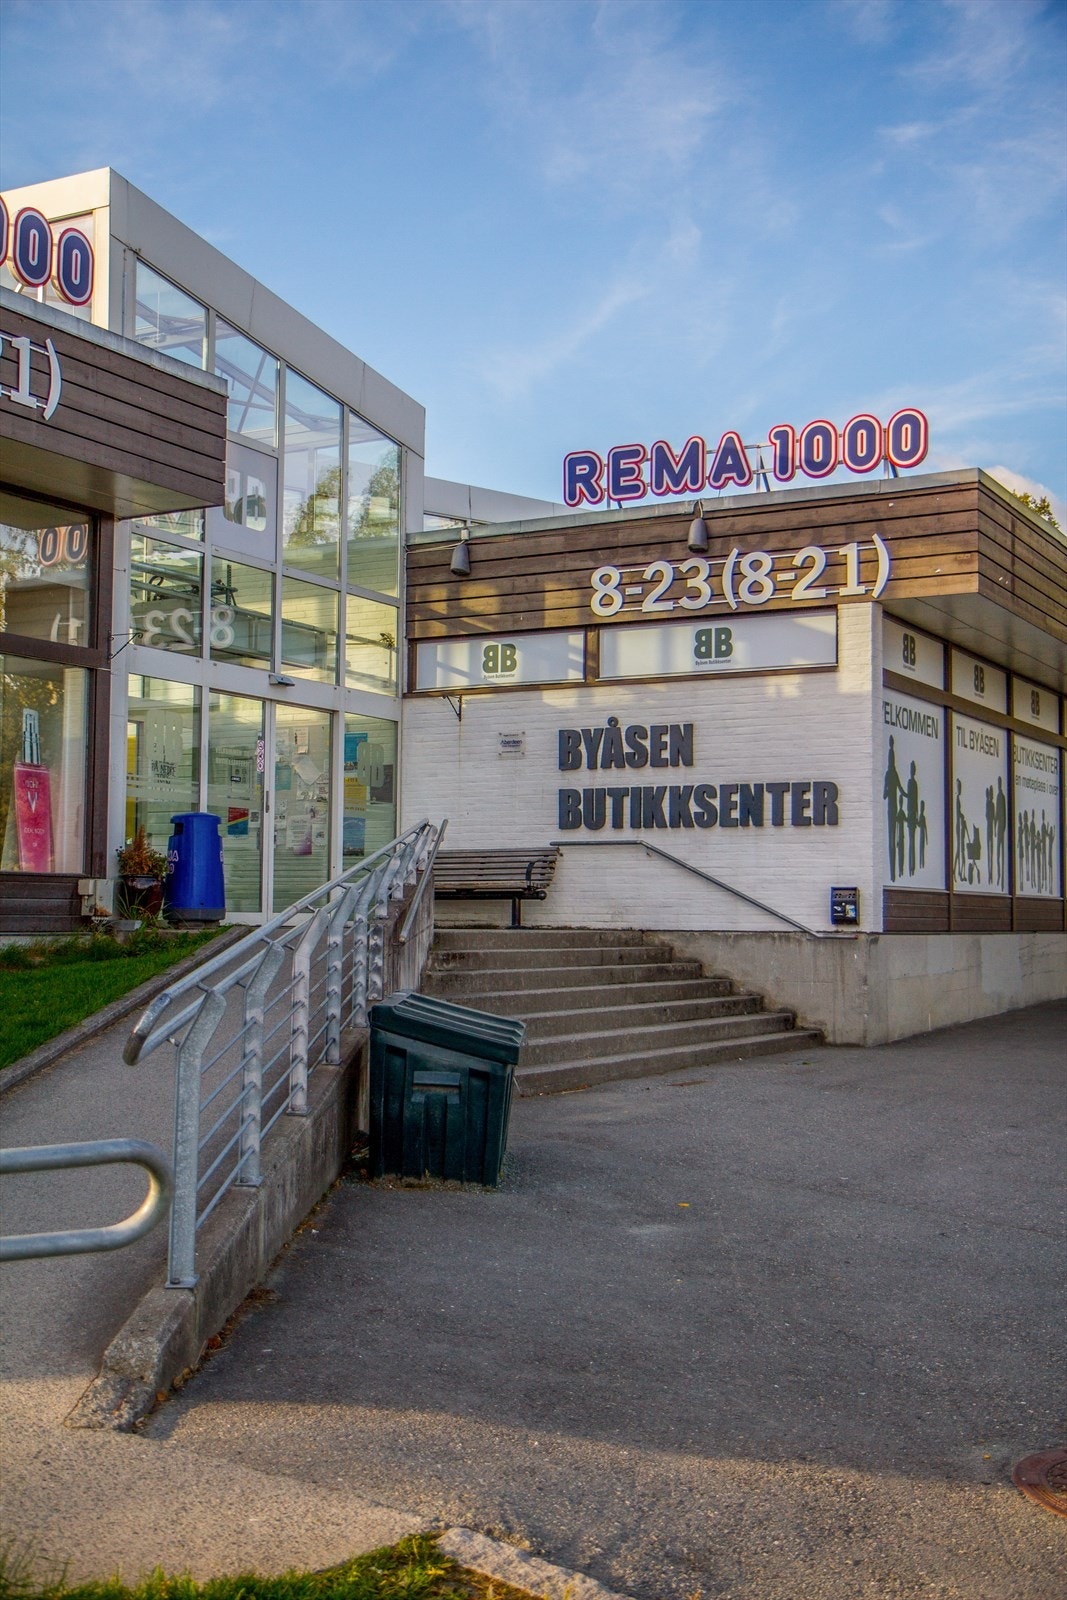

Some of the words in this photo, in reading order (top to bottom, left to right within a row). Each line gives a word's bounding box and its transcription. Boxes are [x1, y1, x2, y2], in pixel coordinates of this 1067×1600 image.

[0, 194, 95, 306] 00
[563, 431, 753, 507] REMA
[769, 408, 929, 483] 1000
[558, 716, 694, 771] BYÅSEN
[956, 726, 968, 748] TIL
[970, 728, 999, 758] BYÅSEN
[558, 781, 839, 830] BUTIKKSENTER
